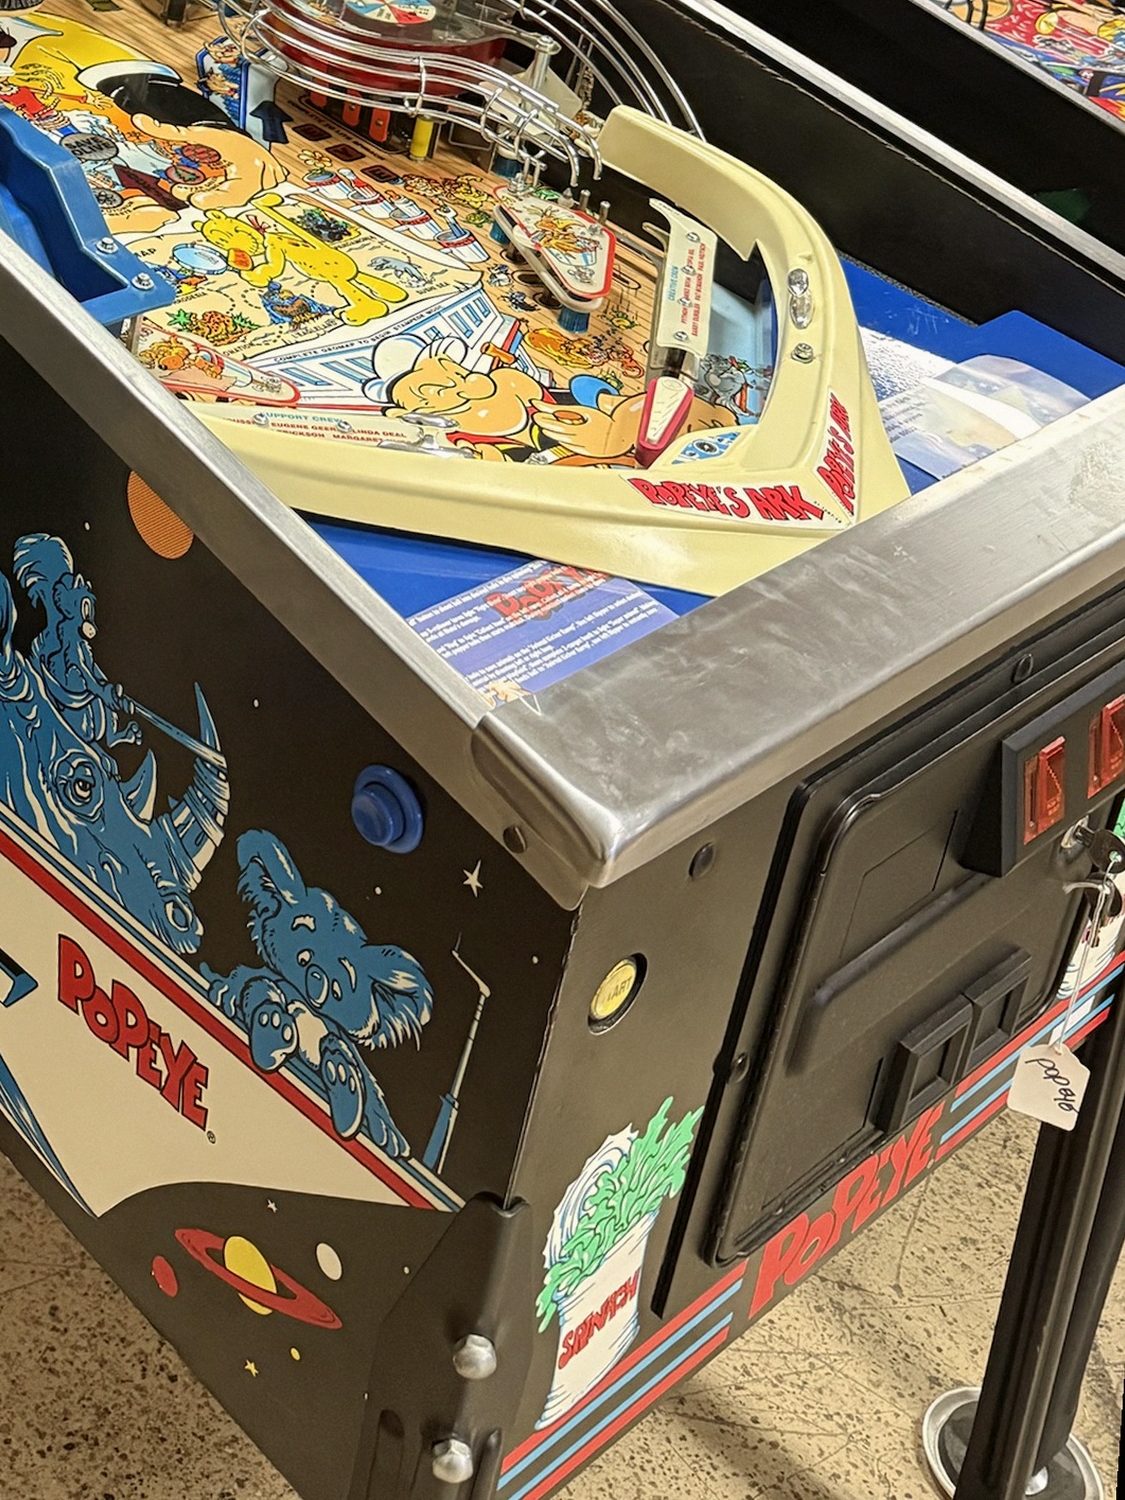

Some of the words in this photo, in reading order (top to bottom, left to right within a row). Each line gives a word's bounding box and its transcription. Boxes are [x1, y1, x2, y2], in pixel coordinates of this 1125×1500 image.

[65, 136, 101, 149] SAVE
[71, 140, 112, 156] OLIVE
[261, 412, 308, 421] UPPORT
[271, 422, 309, 430] EUGENE
[382, 431, 407, 439] DEAL
[628, 478, 750, 518] POPEYE'S
[743, 485, 824, 521] ARK
[58, 934, 209, 1131] POPEYE
[749, 1101, 945, 1320] POPEYE
[558, 1269, 640, 1370] SPINACH
